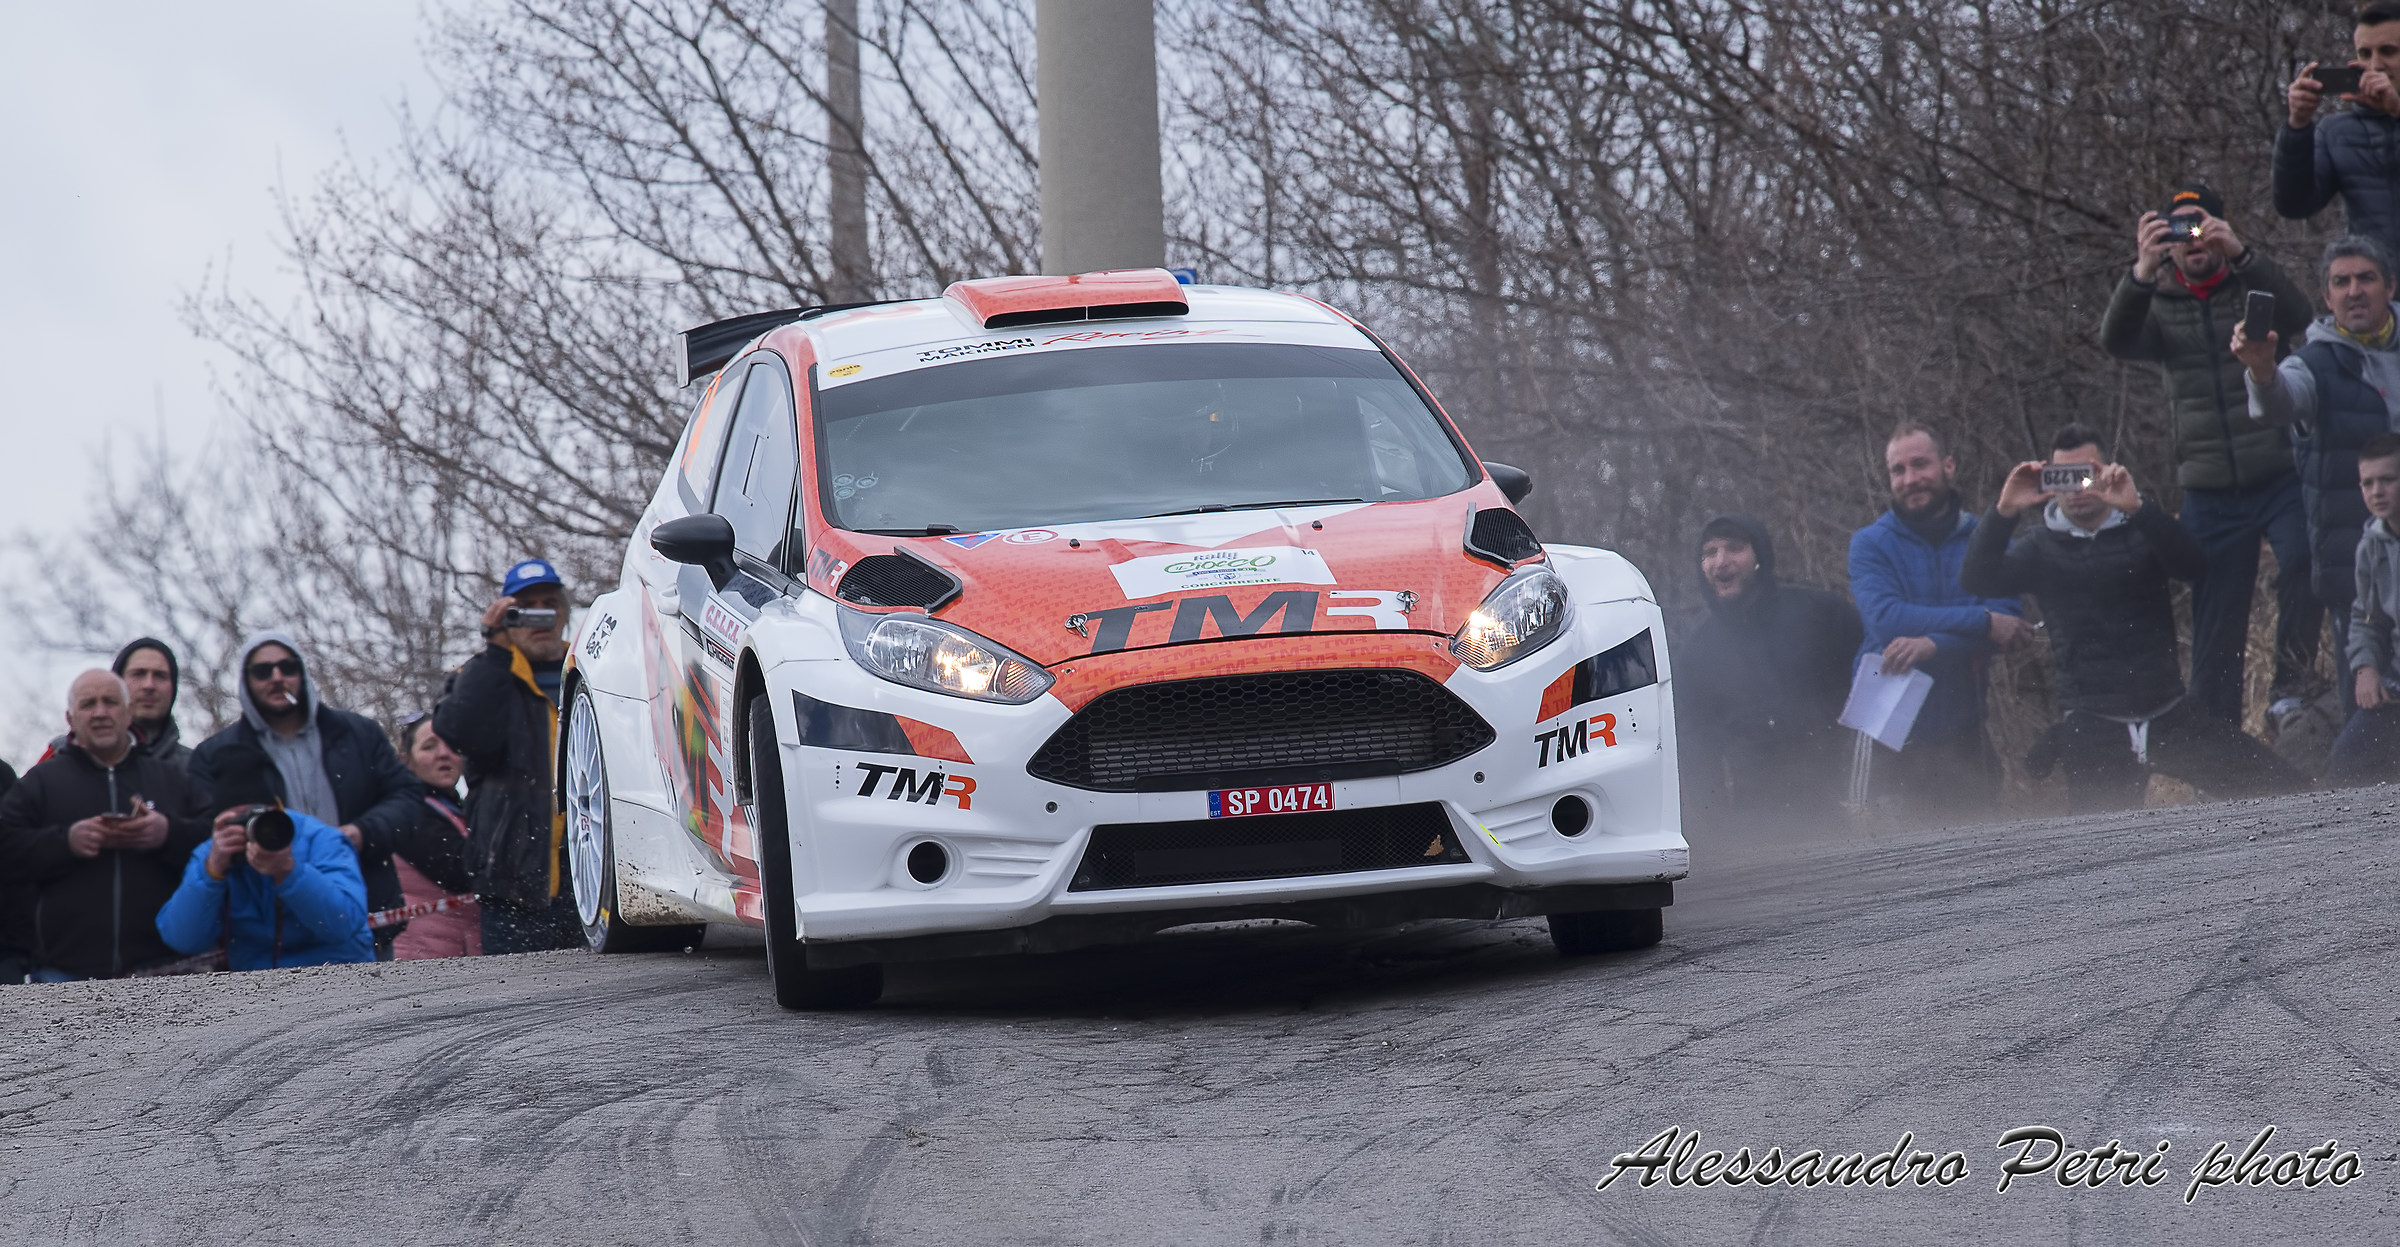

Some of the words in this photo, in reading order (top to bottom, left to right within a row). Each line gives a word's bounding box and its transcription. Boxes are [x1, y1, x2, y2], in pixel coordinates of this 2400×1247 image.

[916, 337, 1033, 357] TOMMI
[919, 342, 1036, 363] MAKINEN
[811, 547, 849, 588] TMR
[1193, 551, 1239, 561] Rally
[1180, 578, 1280, 589] CONCORRENTE
[1084, 590, 1411, 654] TMR
[1533, 712, 1618, 769] TMR
[856, 761, 977, 810] TMR
[1228, 789, 1260, 815] SP
[1268, 785, 1328, 812] 0474
